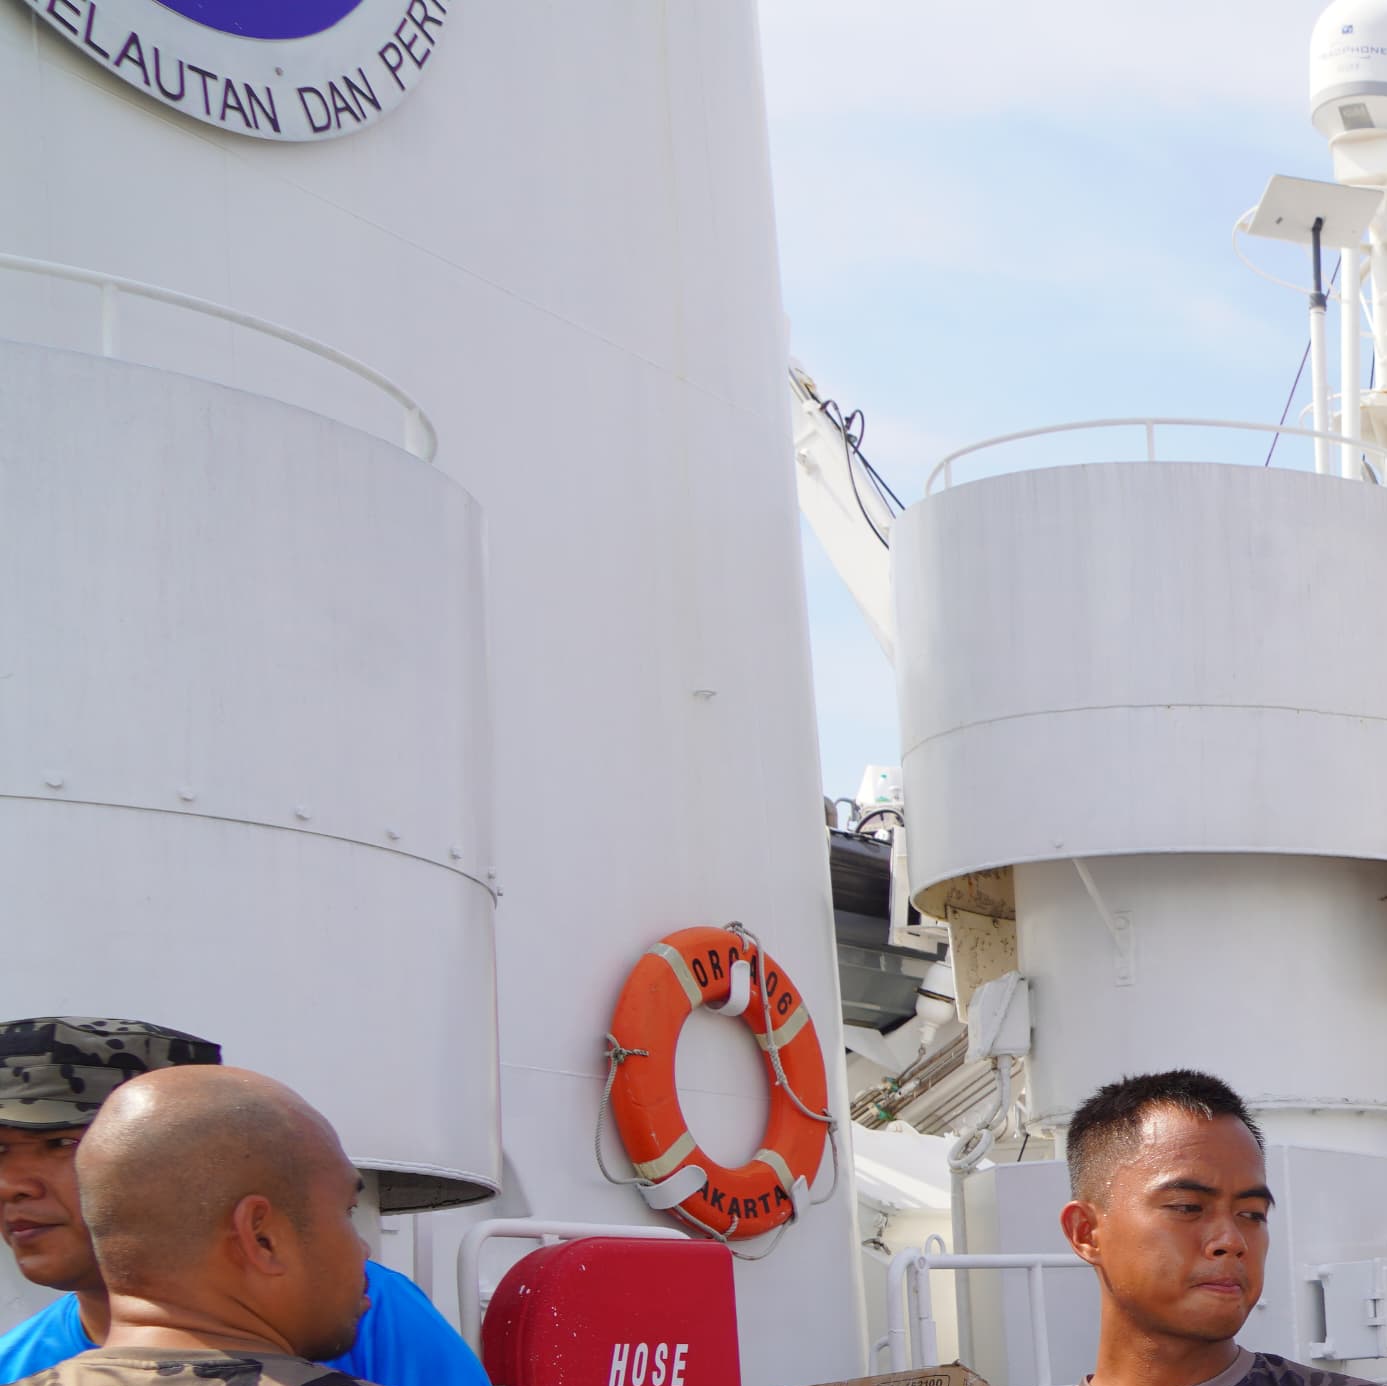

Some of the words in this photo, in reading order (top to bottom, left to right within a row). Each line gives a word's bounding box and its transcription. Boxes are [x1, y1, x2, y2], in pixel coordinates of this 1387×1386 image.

[24, 0, 282, 133] ELAUTAN
[298, 68, 383, 134] DAN
[765, 971, 793, 1016] 06
